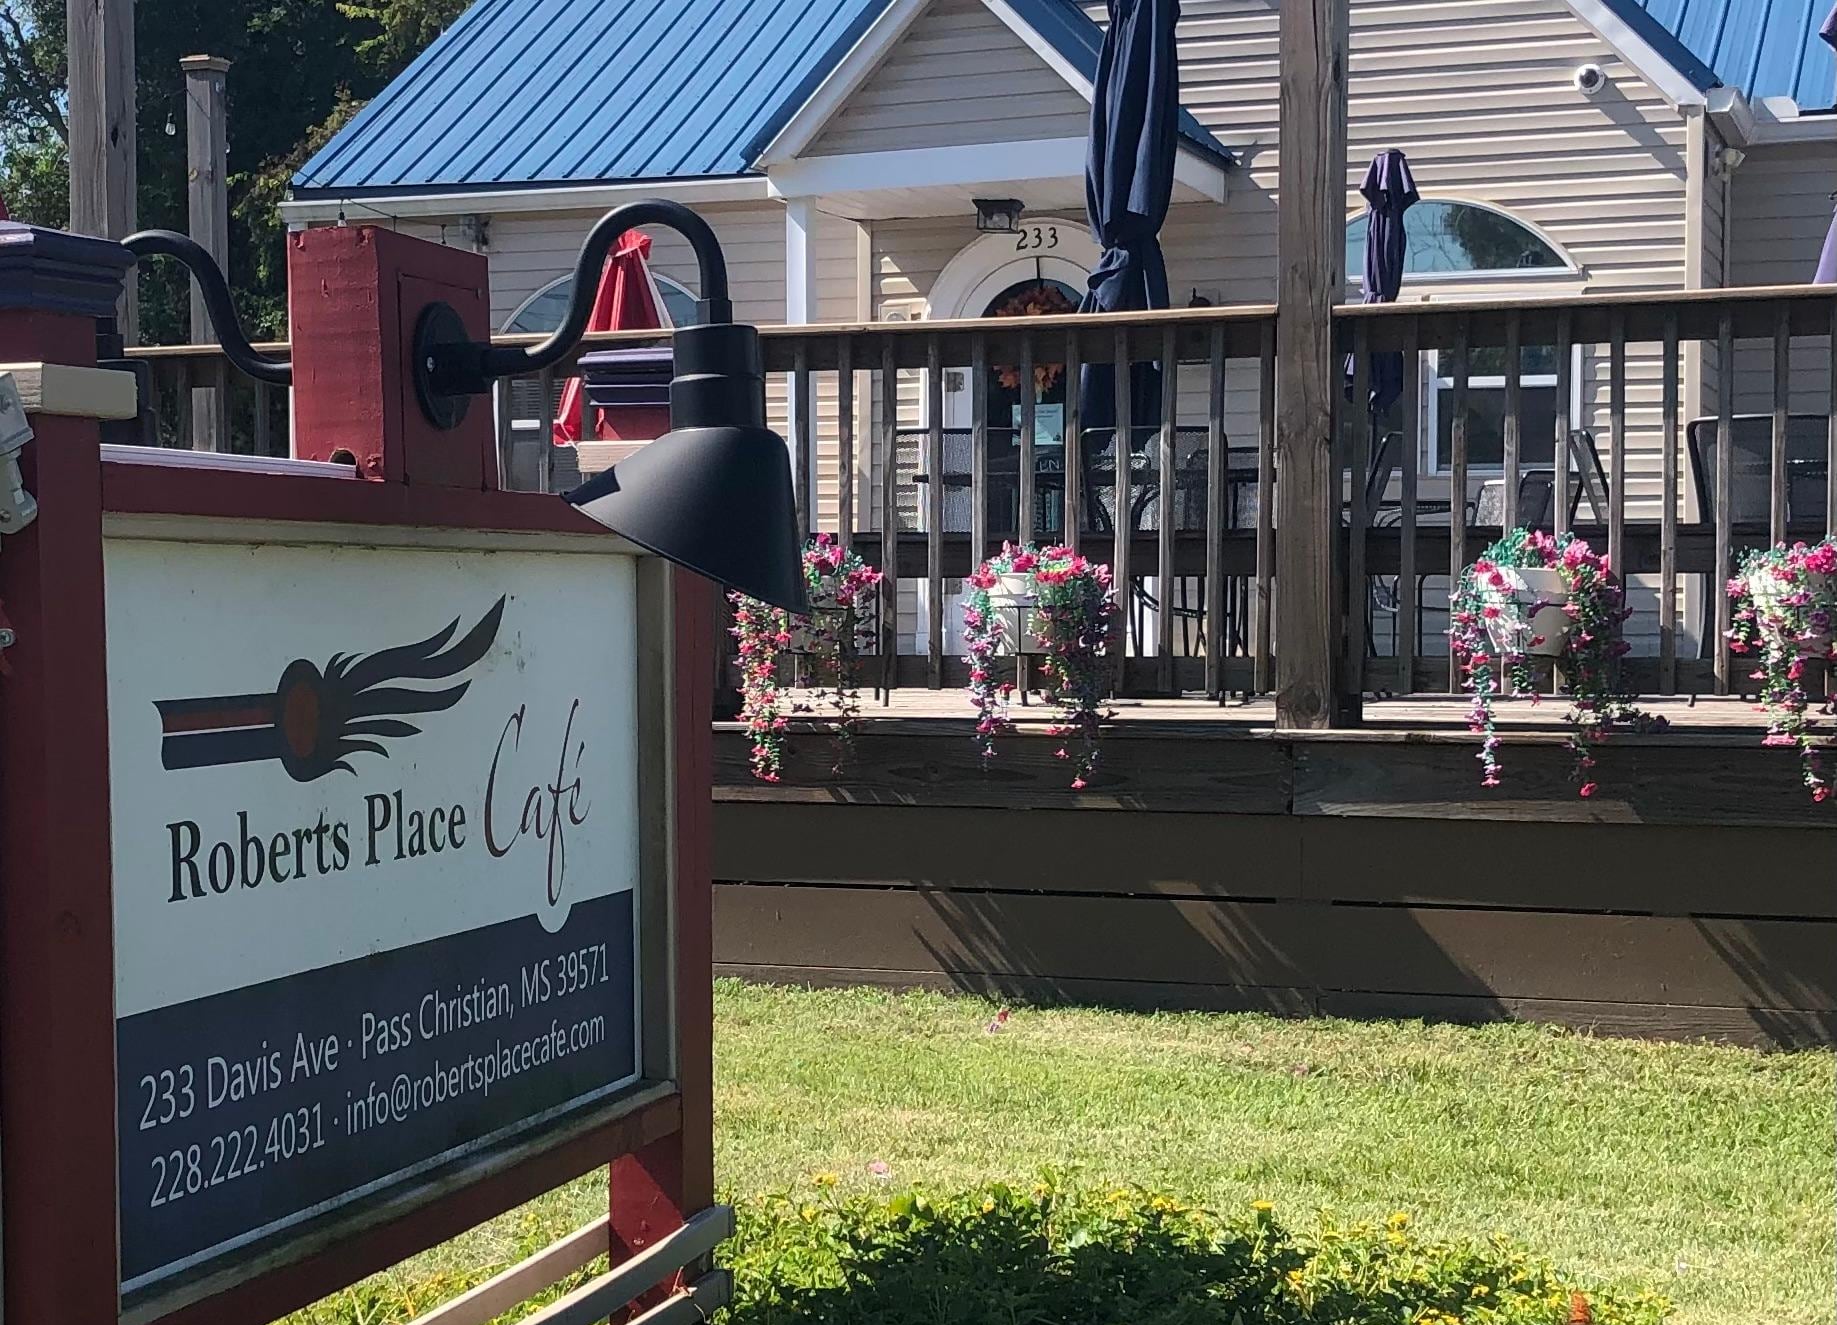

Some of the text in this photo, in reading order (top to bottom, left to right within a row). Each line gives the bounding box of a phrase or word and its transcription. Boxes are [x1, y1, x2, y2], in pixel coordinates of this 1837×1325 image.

[1015, 226, 1059, 251] 233
[165, 698, 592, 907] Roberts Place Café
[139, 942, 609, 1130] 233 Davis Ave Pass Christian, MS 39571
[150, 1014, 606, 1208] 228.222.4031 info@robertsplacecafe.com
